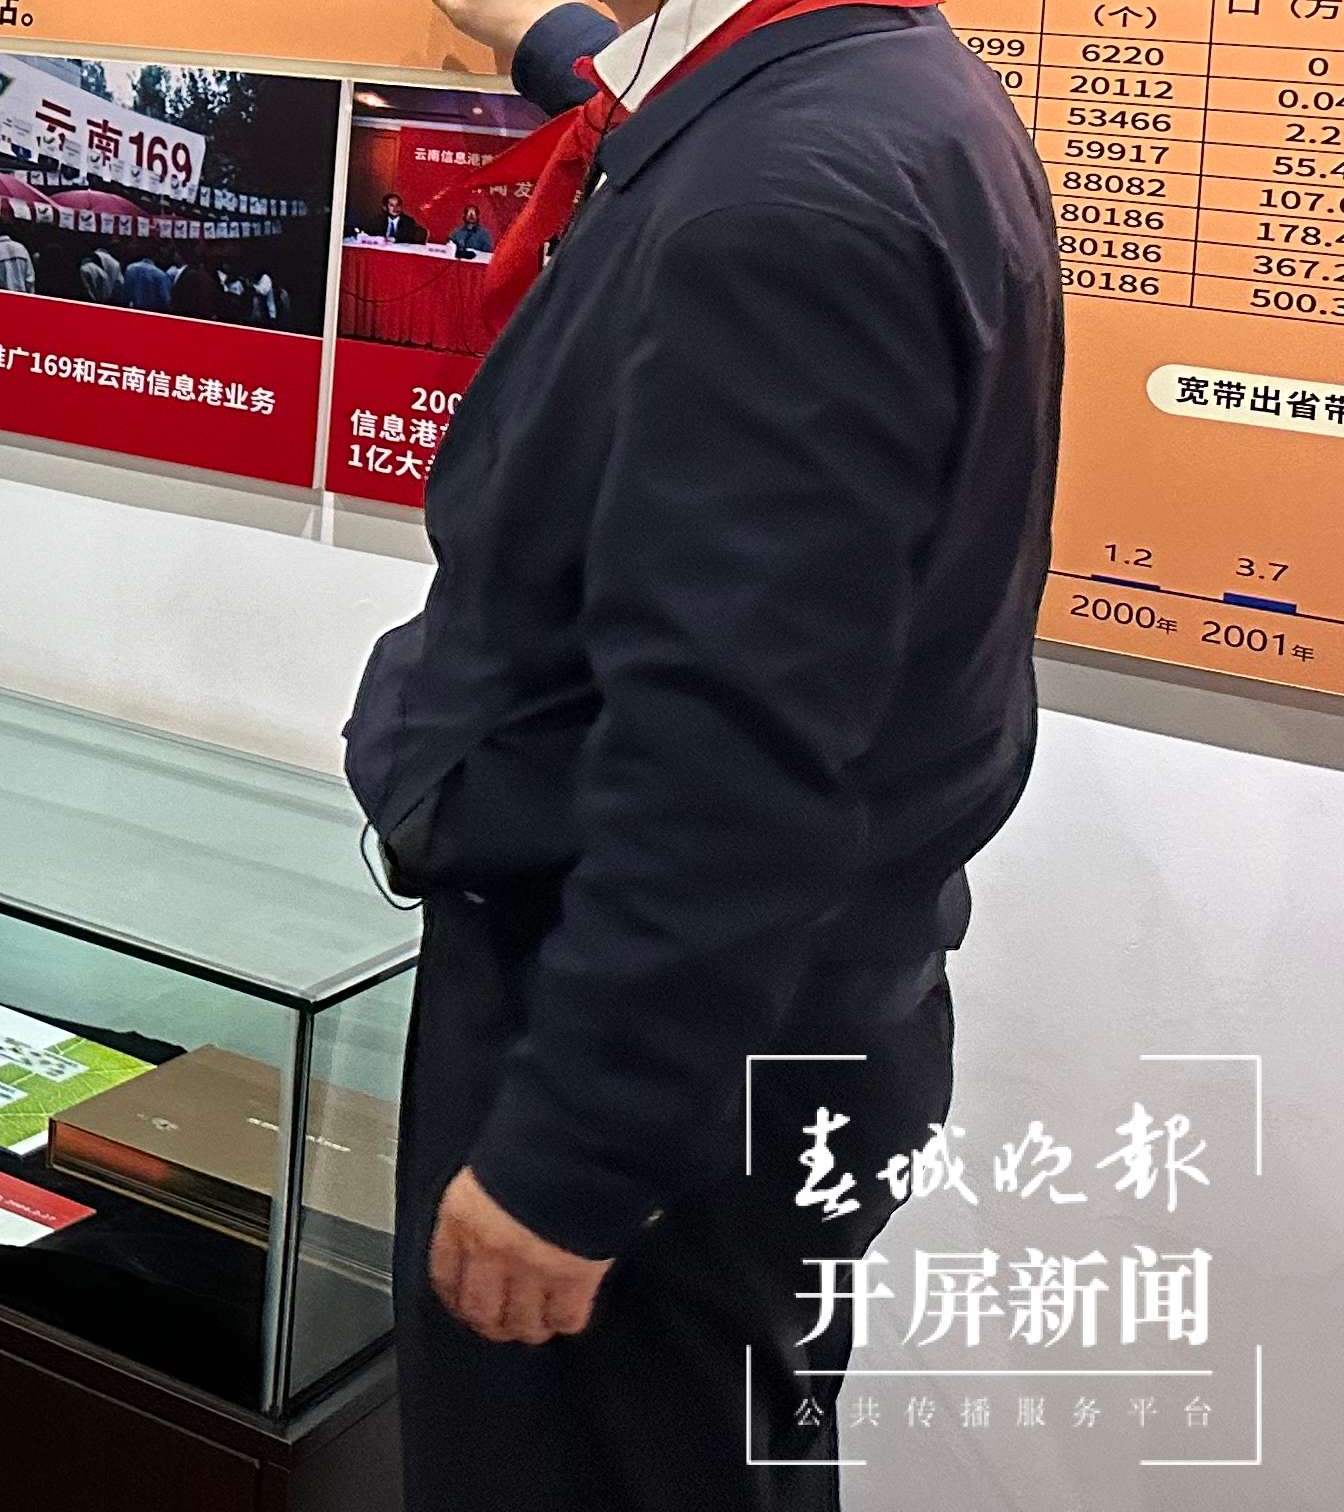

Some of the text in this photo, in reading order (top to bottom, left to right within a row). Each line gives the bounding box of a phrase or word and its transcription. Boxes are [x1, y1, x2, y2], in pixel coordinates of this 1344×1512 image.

[967, 37, 1330, 77] 999 6220 0
[1069, 75, 1174, 99] 20112
[1067, 107, 1172, 132] 53466
[1064, 139, 1170, 165] 59917
[1062, 171, 1344, 213] 88082 107.
[1060, 204, 1165, 230] 80186
[1059, 236, 1162, 263] 80186
[350, 408, 450, 449] 信息港
[347, 444, 436, 481] 1亿大
[1104, 543, 1290, 582] 1.2 3.7
[1069, 594, 1316, 663] 2000年 2001年
